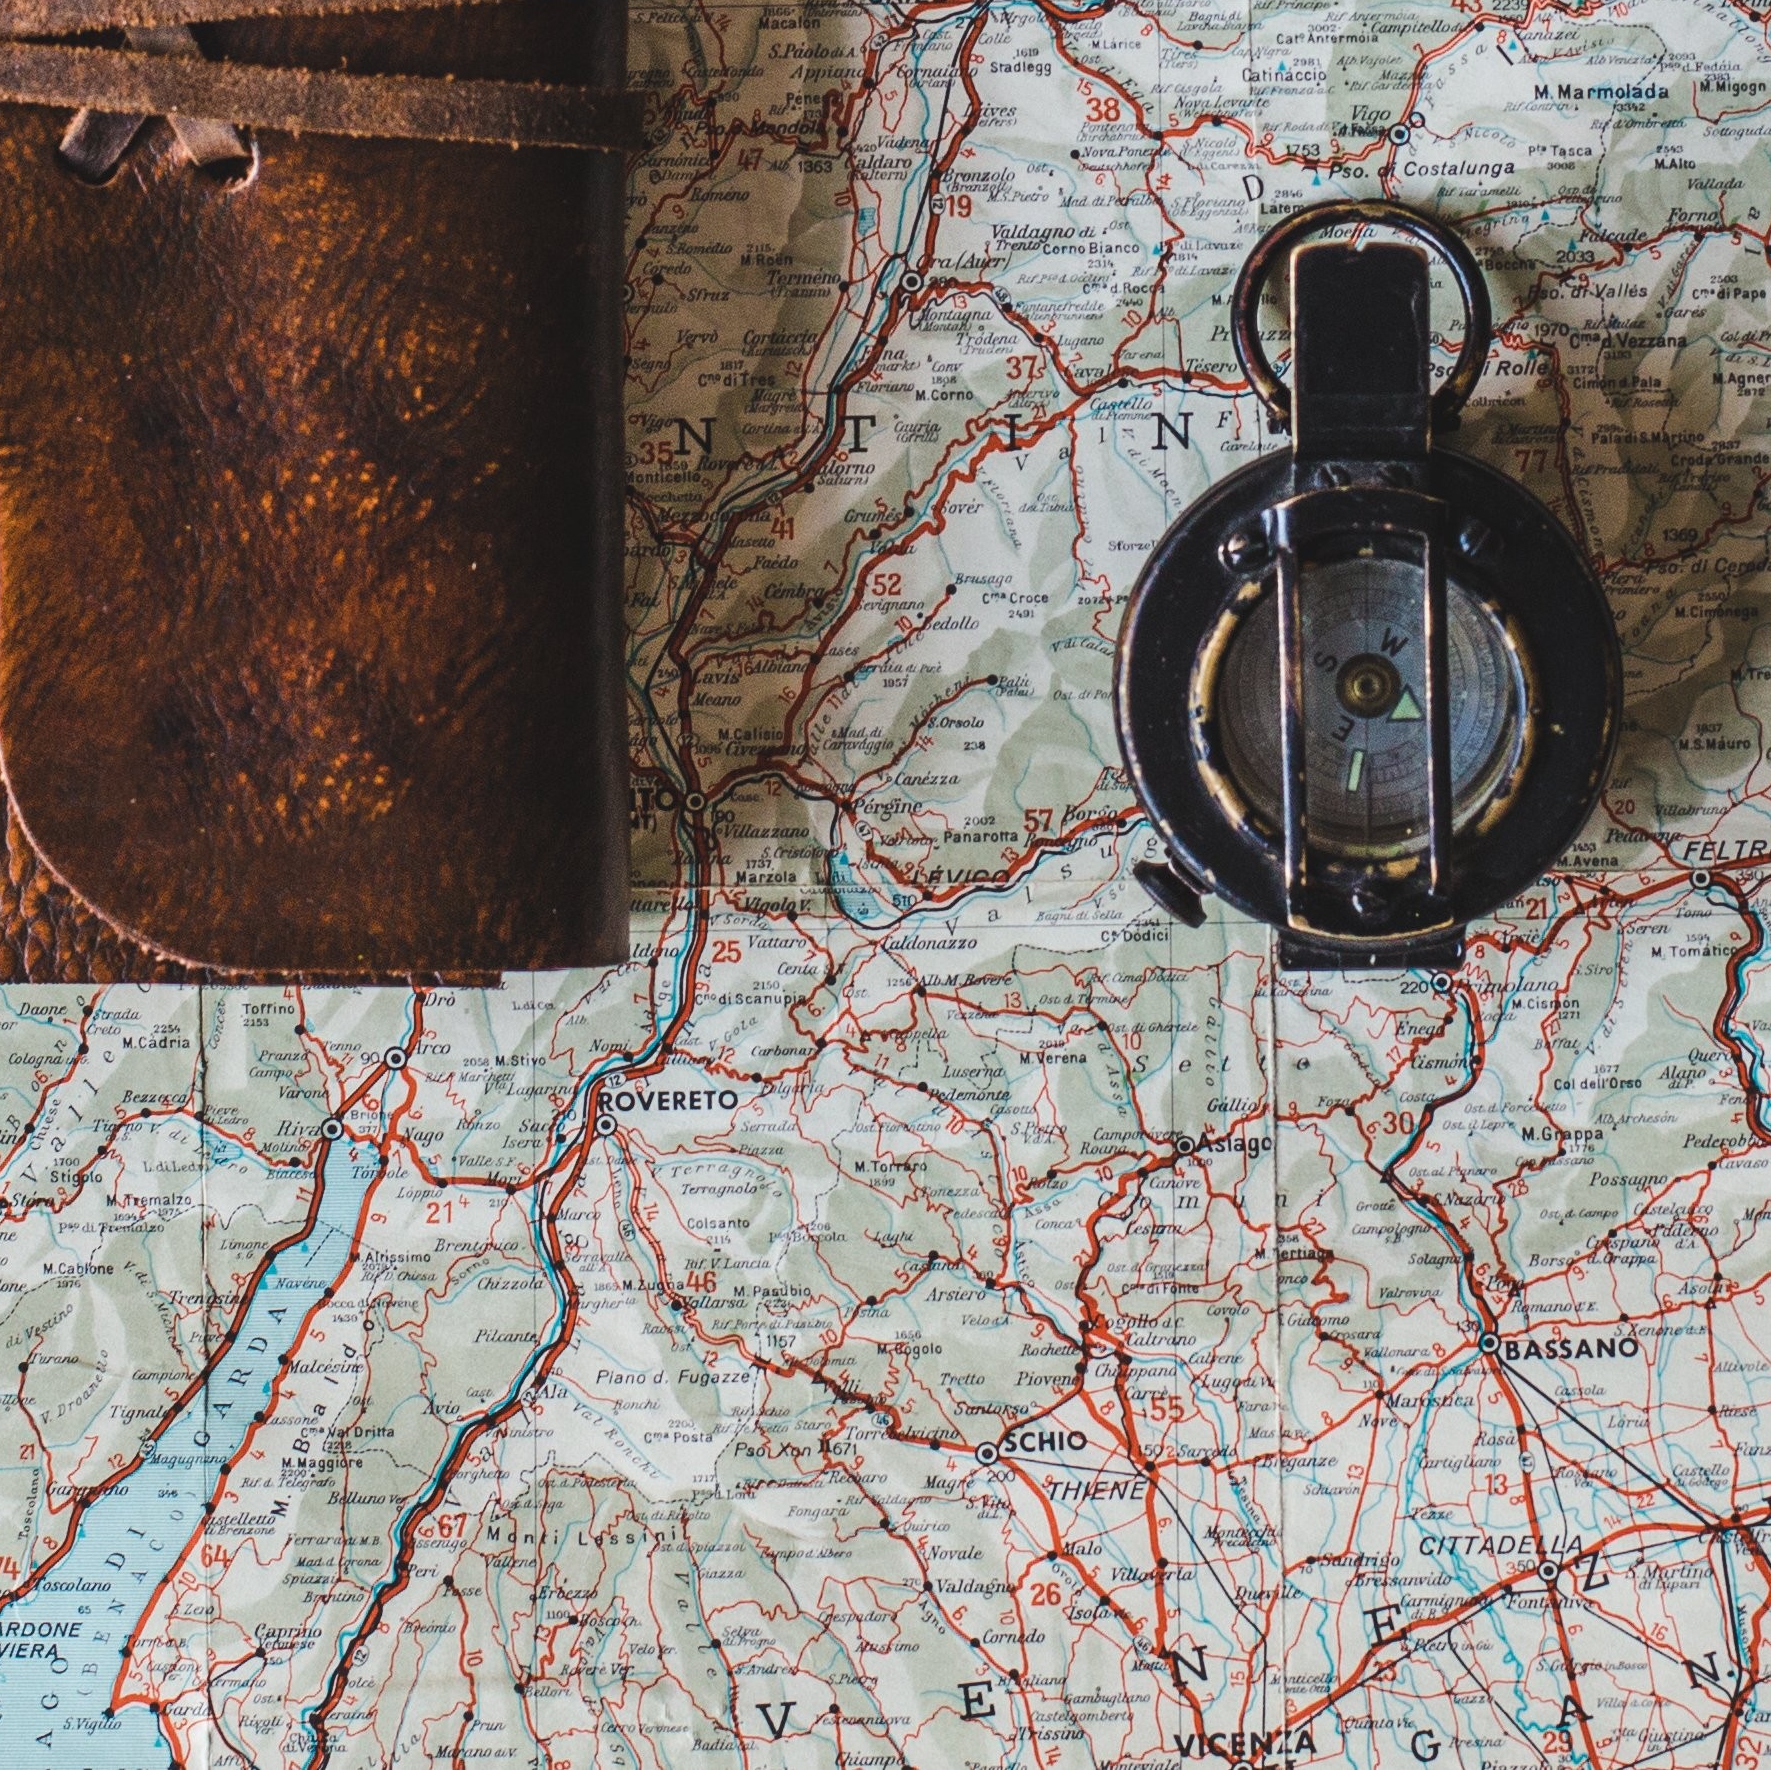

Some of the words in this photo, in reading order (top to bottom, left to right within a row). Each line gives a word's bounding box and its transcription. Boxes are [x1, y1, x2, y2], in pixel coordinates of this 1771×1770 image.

[1085, 98, 1120, 124] 38
[1381, 627, 1409, 657] W
[1332, 714, 1355, 742] E
[712, 941, 741, 963] 25
[596, 1088, 738, 1112] ROVERETO
[1503, 1335, 1640, 1361] BASSANO
[1003, 1427, 1088, 1452] SCHIO
[1047, 1479, 1147, 1504] THIENE
[201, 1543, 231, 1569] 64
[1420, 1535, 1584, 1557] CITTADELLA
[1031, 1582, 1061, 1605] 26
[1172, 1730, 1317, 1758] VICENZA
